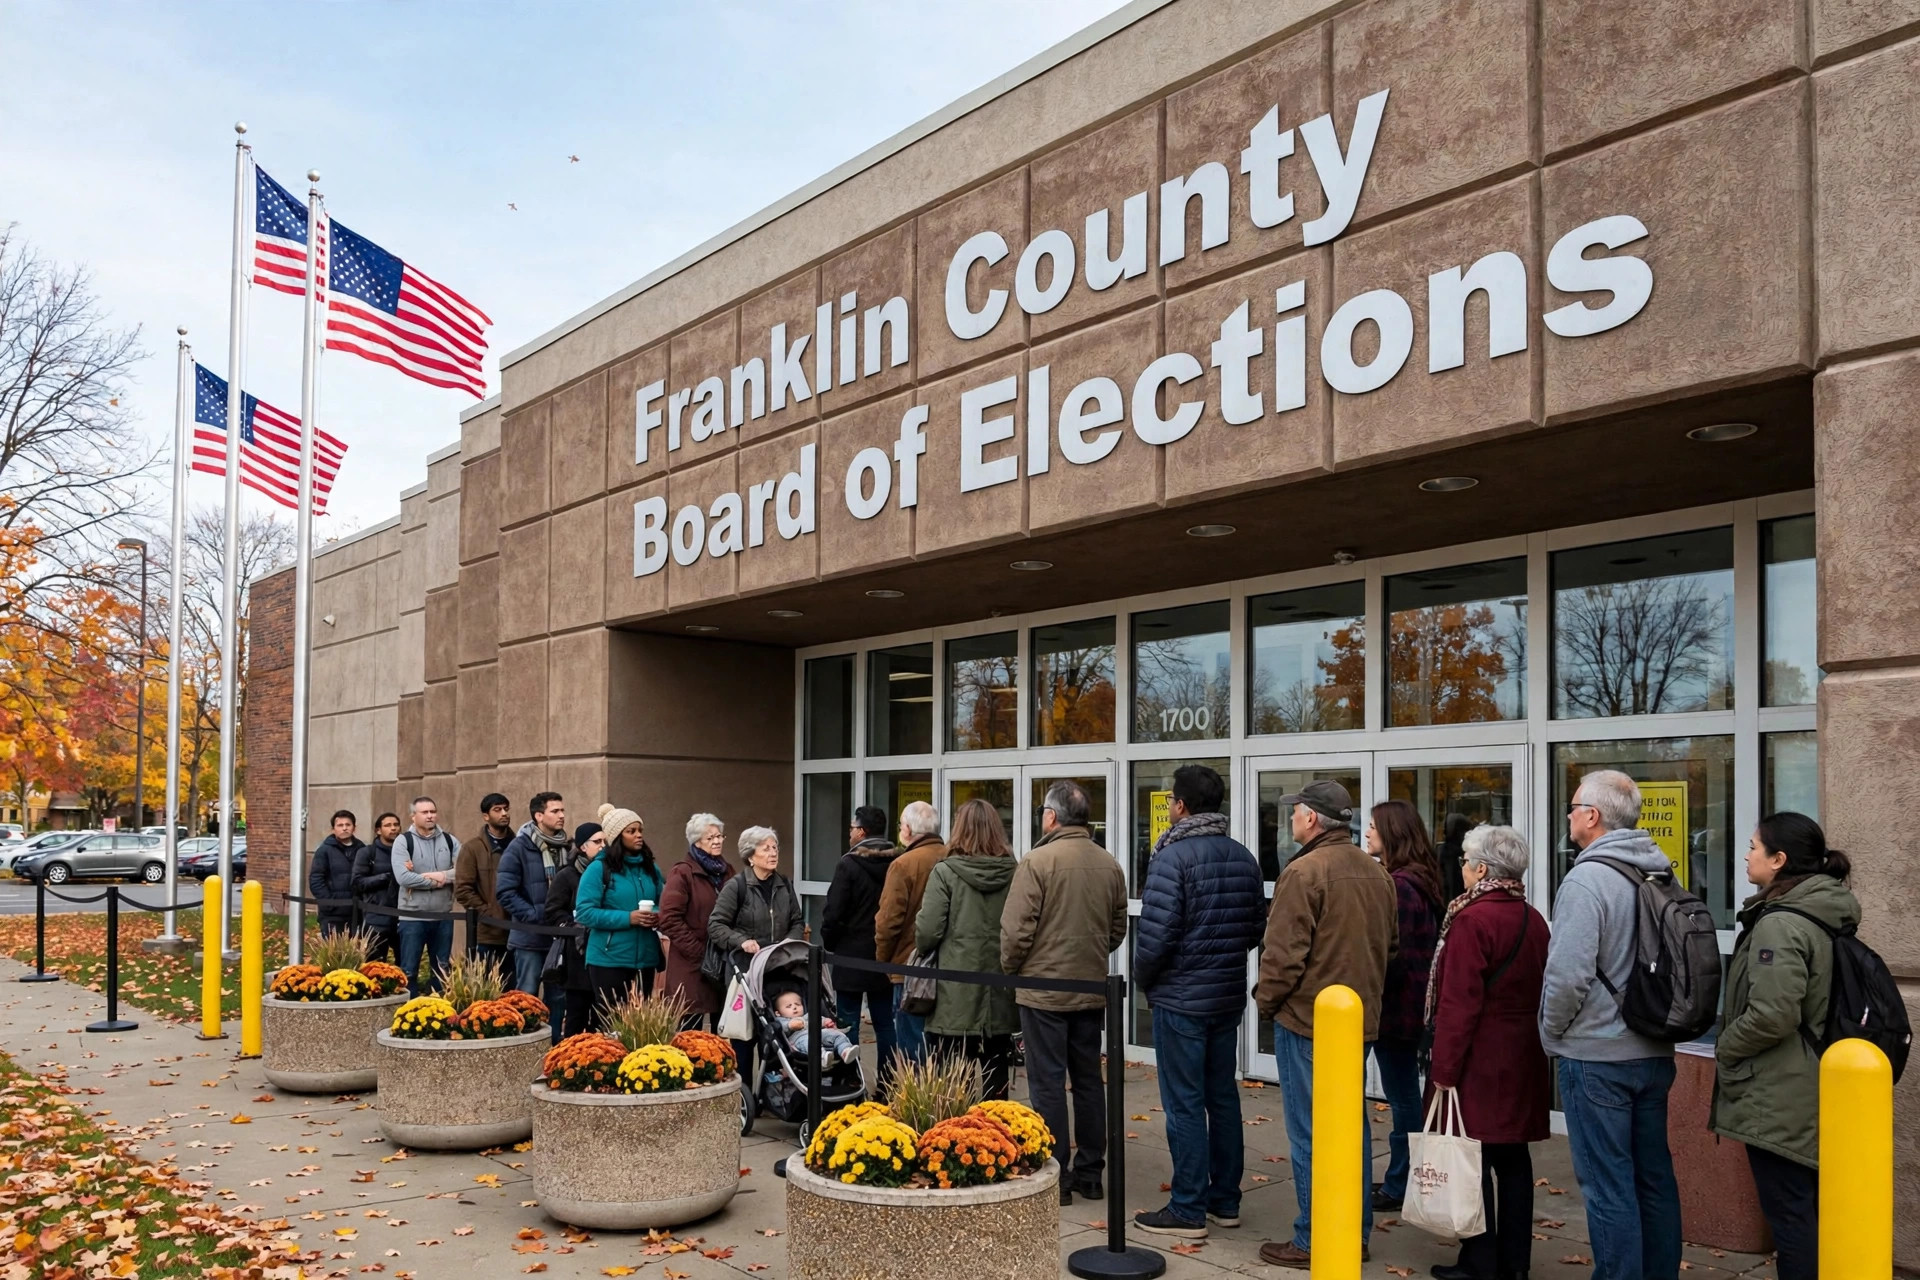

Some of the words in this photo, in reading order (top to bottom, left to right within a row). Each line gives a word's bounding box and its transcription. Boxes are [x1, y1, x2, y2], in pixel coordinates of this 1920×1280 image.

[632, 442, 817, 579] Board
[843, 404, 930, 520] of
[959, 214, 1654, 493] Elections
[634, 291, 911, 466] Franklin
[944, 87, 1391, 341] County
[1159, 706, 1210, 733] 1700
